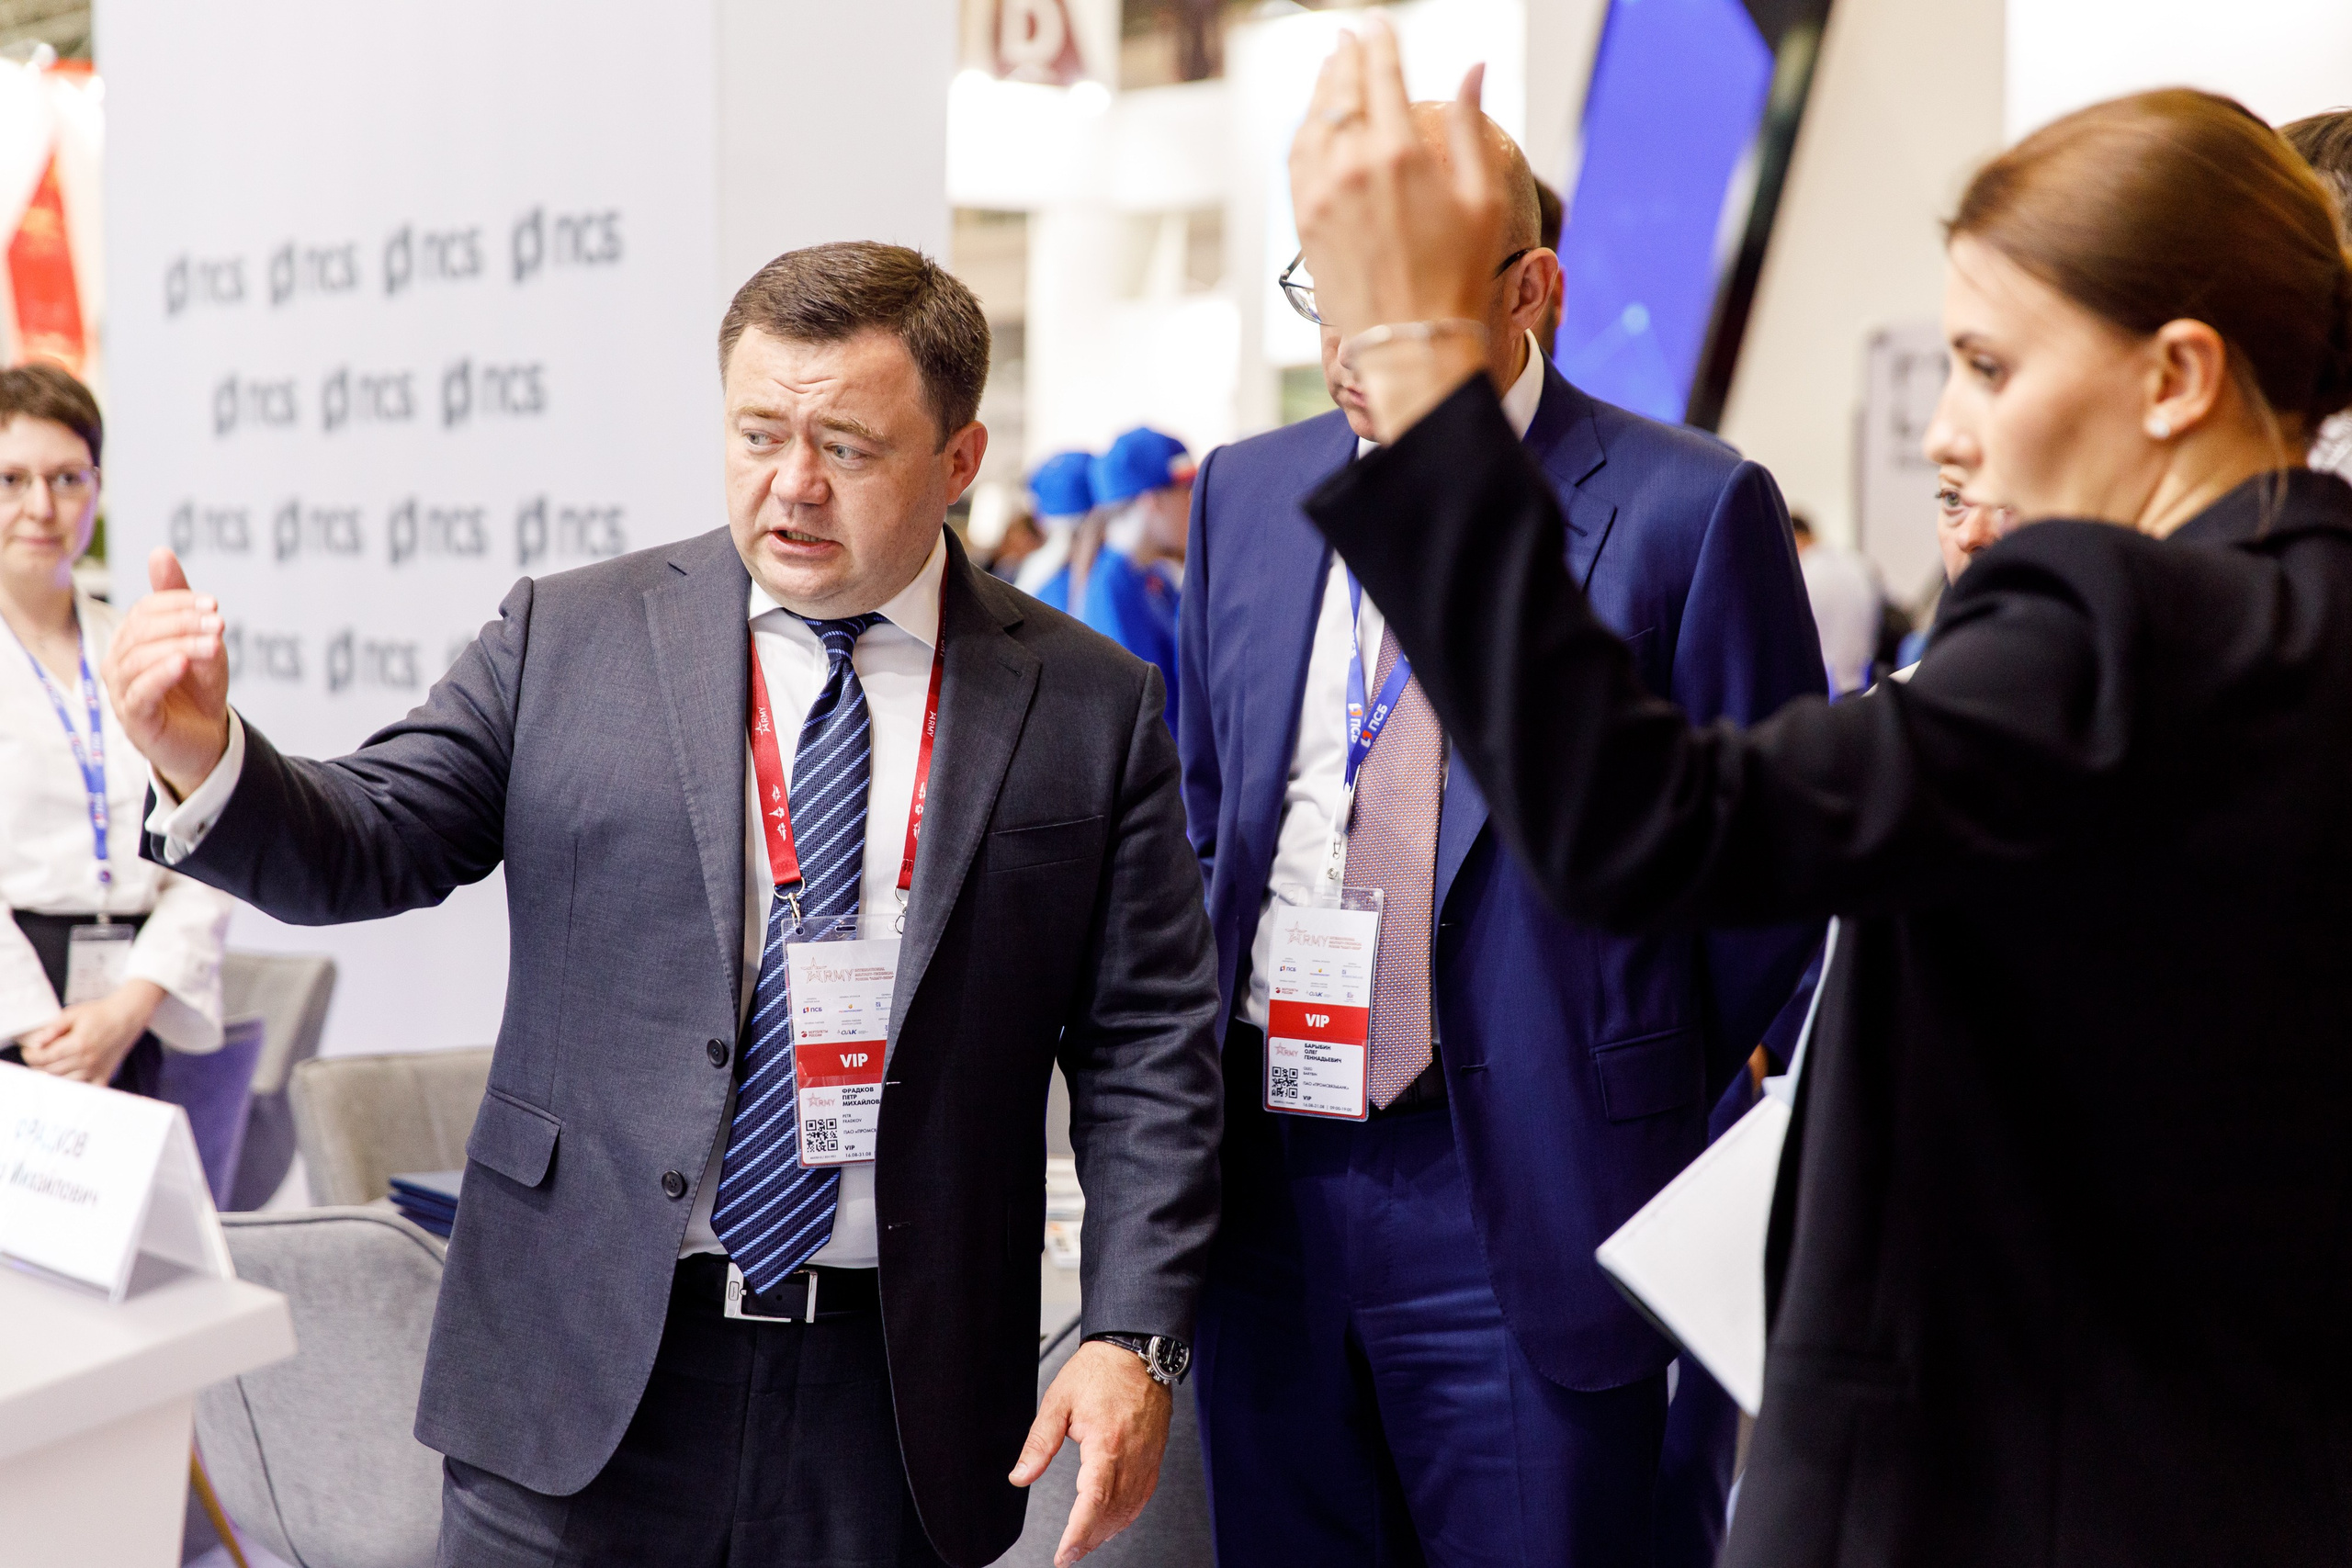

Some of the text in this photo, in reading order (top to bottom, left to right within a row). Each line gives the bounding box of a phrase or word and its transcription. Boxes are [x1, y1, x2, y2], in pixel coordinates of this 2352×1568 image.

[1368, 703, 1387, 730] ПСБ
[1306, 1013, 1329, 1028] VIP
[840, 1053, 868, 1068] VIP
[1304, 1055, 1341, 1063] ГЕННАДЬЕВИЧ
